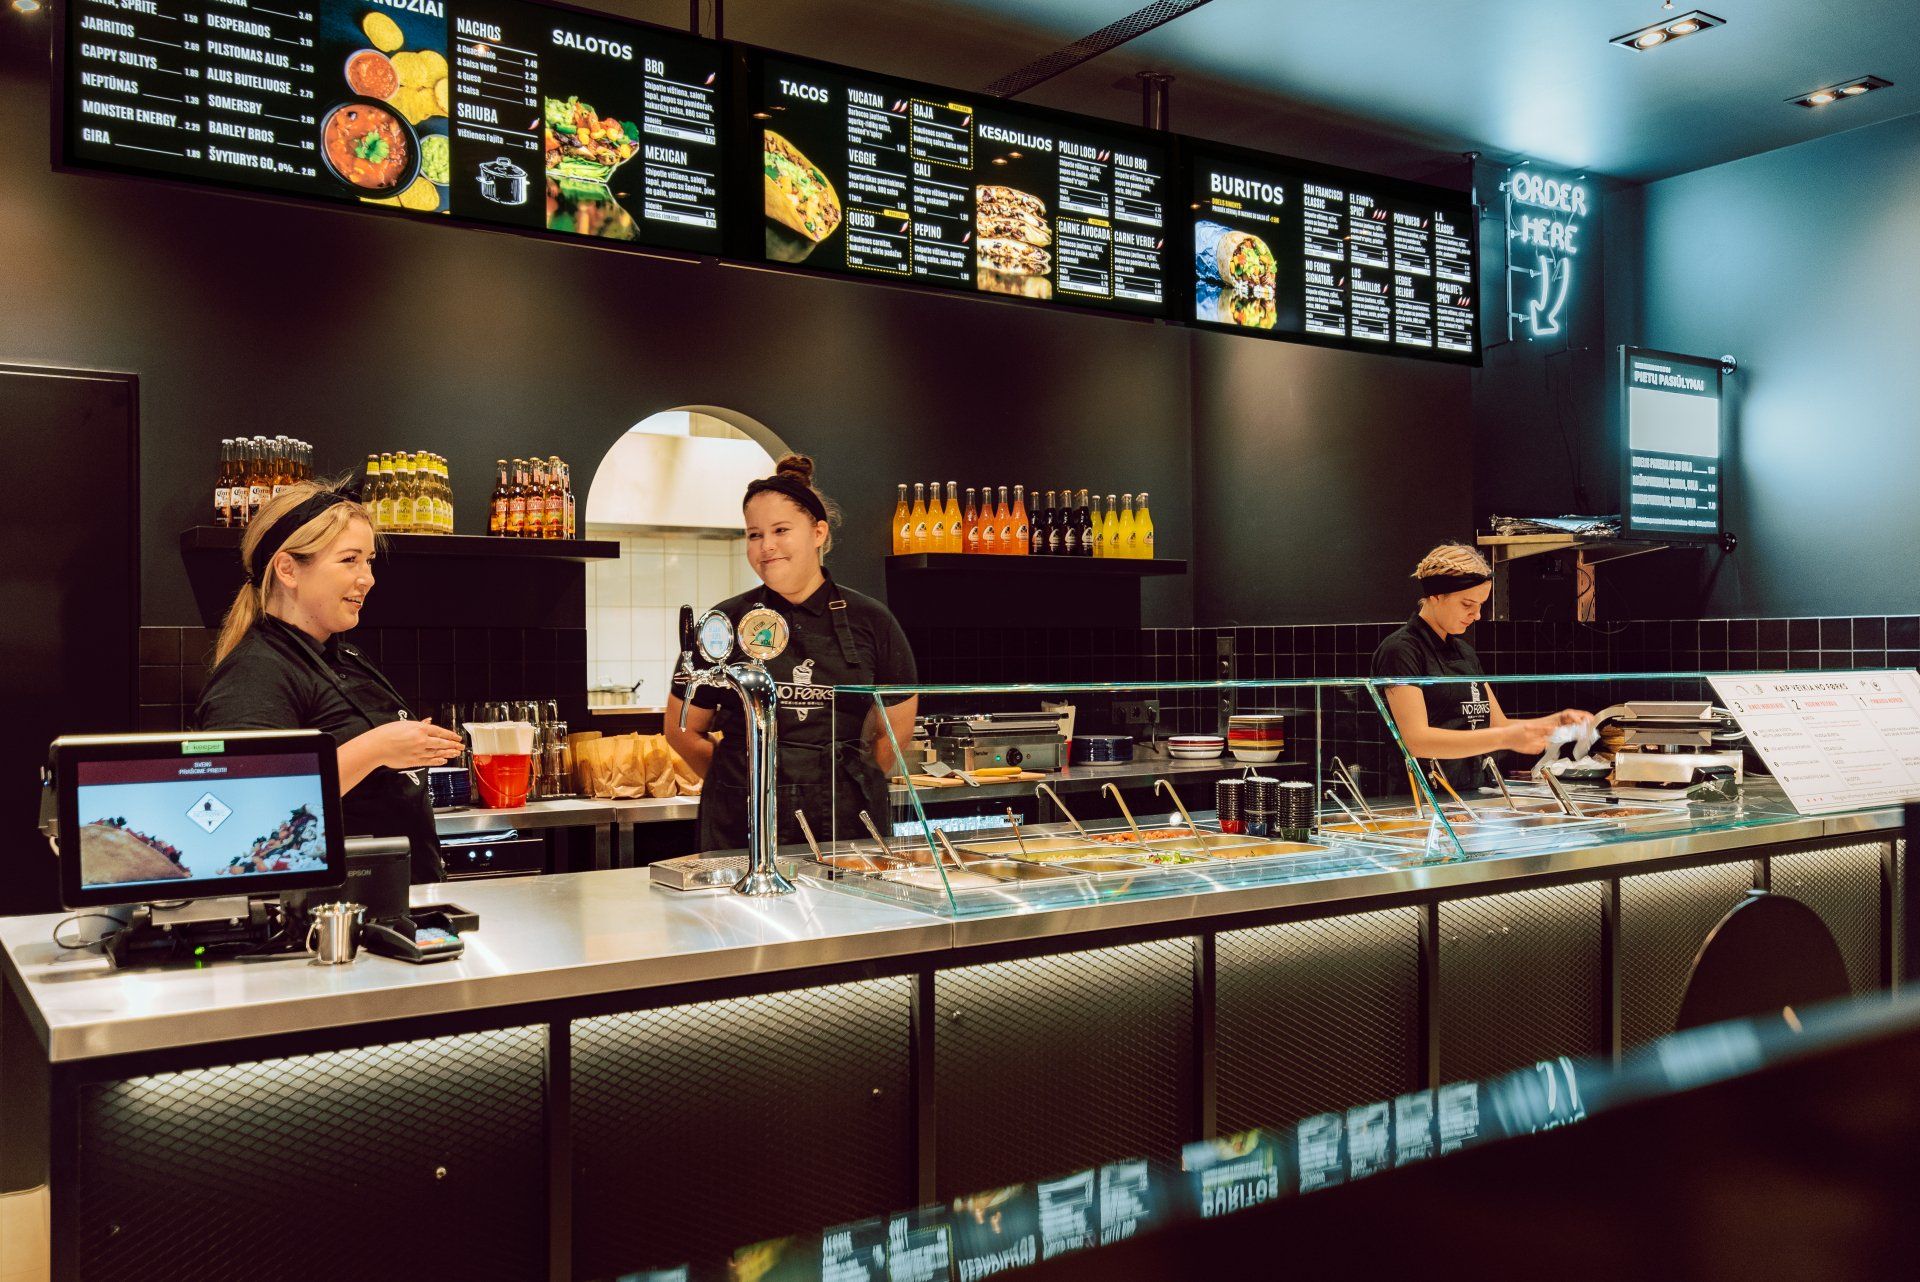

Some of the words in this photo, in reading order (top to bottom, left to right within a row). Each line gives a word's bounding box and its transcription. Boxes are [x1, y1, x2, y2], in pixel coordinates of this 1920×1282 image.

[121, 0, 157, 15] SPRITE
[81, 16, 135, 38] JARRITOS
[207, 14, 271, 39] DESPERADOS
[457, 18, 502, 41] NACHOS
[208, 40, 263, 63] PILSTOMAS
[265, 52, 289, 68] ALUS
[457, 44, 462, 52] &
[553, 29, 633, 60] SALOTOS
[82, 44, 118, 62] CAPPY
[119, 50, 157, 70] SULTYS
[457, 57, 462, 66] &
[463, 58, 479, 70] Salsa
[480, 62, 498, 73] Verde
[645, 58, 664, 77] BBQ
[81, 72, 139, 94] NEPTŪNAS
[207, 67, 233, 84] ALUS
[234, 72, 292, 95] BUTELIUOSE
[458, 71, 462, 79] &
[463, 71, 482, 84] Queso
[458, 84, 462, 93] &
[463, 85, 480, 96] Salsa
[780, 79, 829, 103] TACOS
[848, 88, 884, 109] YUCATAN
[82, 100, 135, 120] MONSTER
[136, 108, 177, 127] ENERGY
[208, 94, 263, 115] SOMERSBY
[458, 103, 498, 124] SRIUBA
[914, 103, 934, 120] BAJA
[82, 128, 111, 145] GIRA
[209, 121, 246, 139] BARLEY
[248, 128, 275, 143] BROS
[458, 128, 486, 143] Vištienos
[487, 133, 504, 145] Fajita
[979, 124, 1052, 152] KESADILIJOS
[209, 146, 258, 168] ŠVYTURYS
[260, 157, 277, 173] GO,
[278, 163, 294, 173] 0%
[645, 145, 688, 166] MEXICAN
[849, 149, 877, 166] VEGGIE
[1059, 141, 1079, 156] POLLO
[1080, 146, 1096, 160] LOCO
[914, 163, 930, 178] CALI
[1115, 153, 1133, 168] POLLO
[1135, 157, 1147, 172] BBQ
[1211, 173, 1284, 205] BURITOS
[1304, 183, 1315, 196] SAN
[1316, 186, 1343, 202] FRANCISCO
[1512, 172, 1586, 216] ORDER
[1304, 196, 1326, 210] CLASSIC
[849, 212, 875, 228] QUESO
[1059, 220, 1080, 236] CARNE
[915, 223, 942, 239] PEPINO
[1115, 231, 1135, 245] CARNE
[1136, 235, 1155, 248] VERDE
[1522, 216, 1578, 254] HERE
[1306, 260, 1313, 271] NO
[1462, 704, 1473, 715] NO
[1735, 702, 1744, 712] 3
[1792, 699, 1801, 710] 2
[349, 869, 371, 877] EPSON
